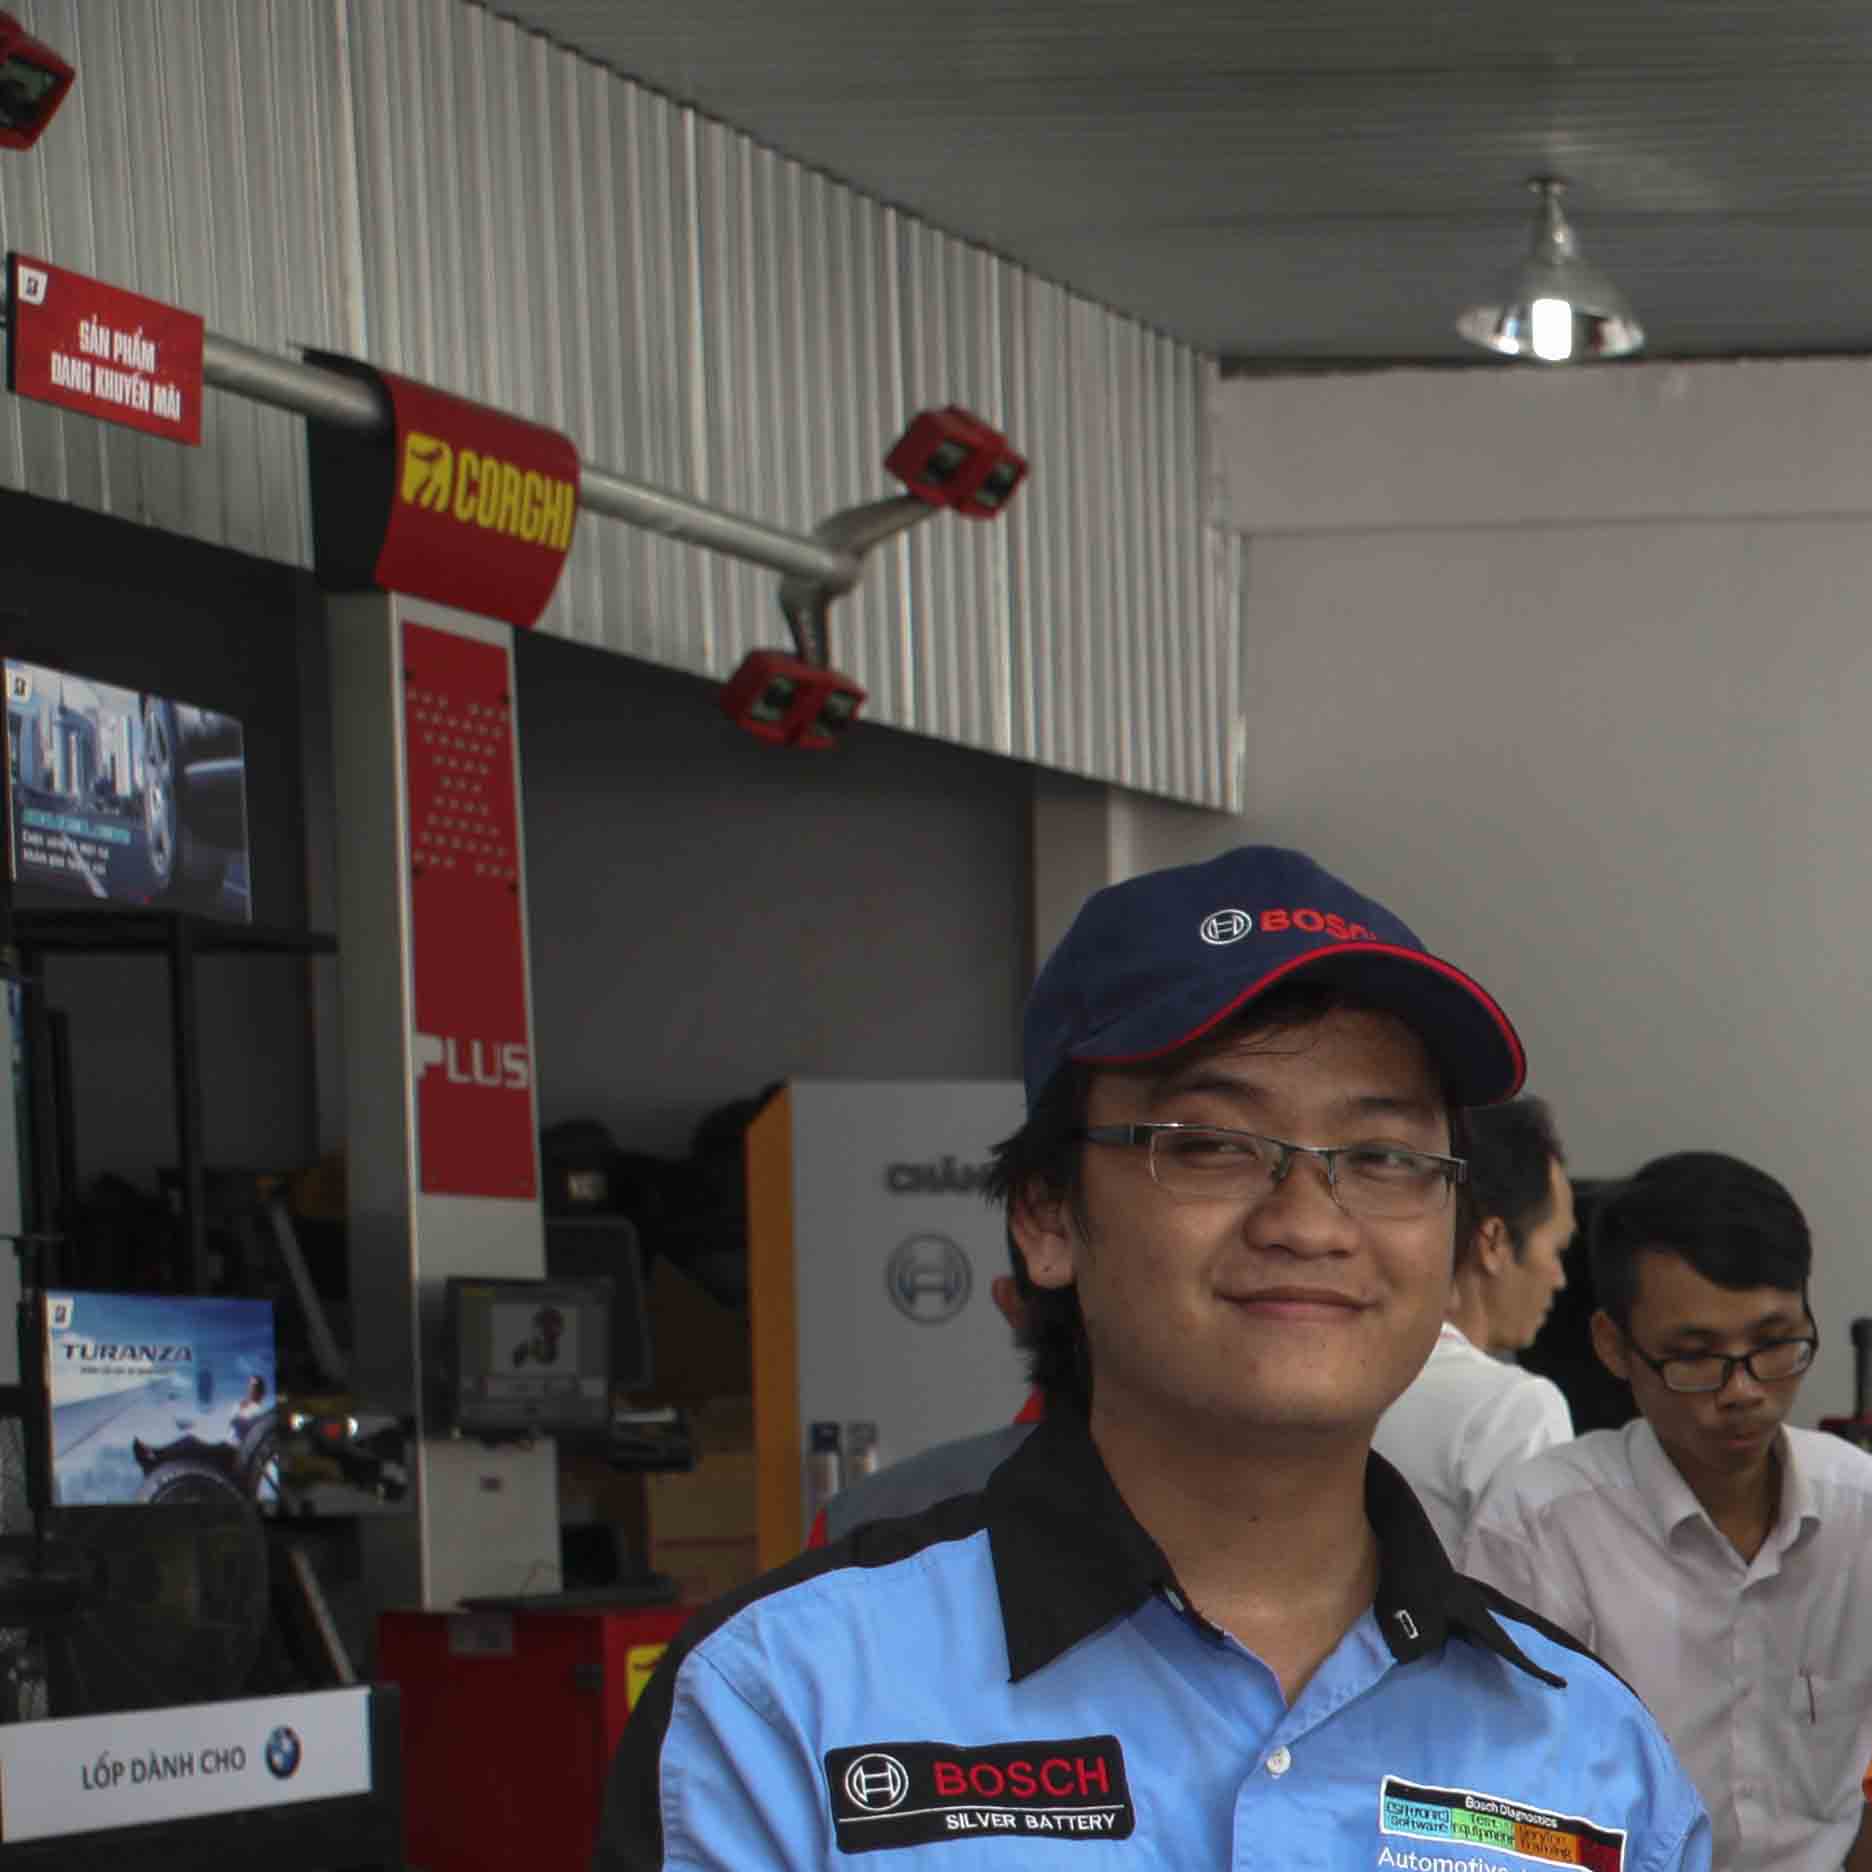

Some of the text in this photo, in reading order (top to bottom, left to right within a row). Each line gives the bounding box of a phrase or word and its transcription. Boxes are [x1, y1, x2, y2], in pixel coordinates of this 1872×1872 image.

[455, 449, 575, 551] CORGHI
[412, 1033, 529, 1088] PLUS
[64, 1343, 193, 1361] TURANZA
[82, 1746, 247, 1790] LỐP DÀNH CHO
[933, 1756, 1110, 1798] BOSCH
[945, 1812, 1115, 1831] SILVER BATTERY
